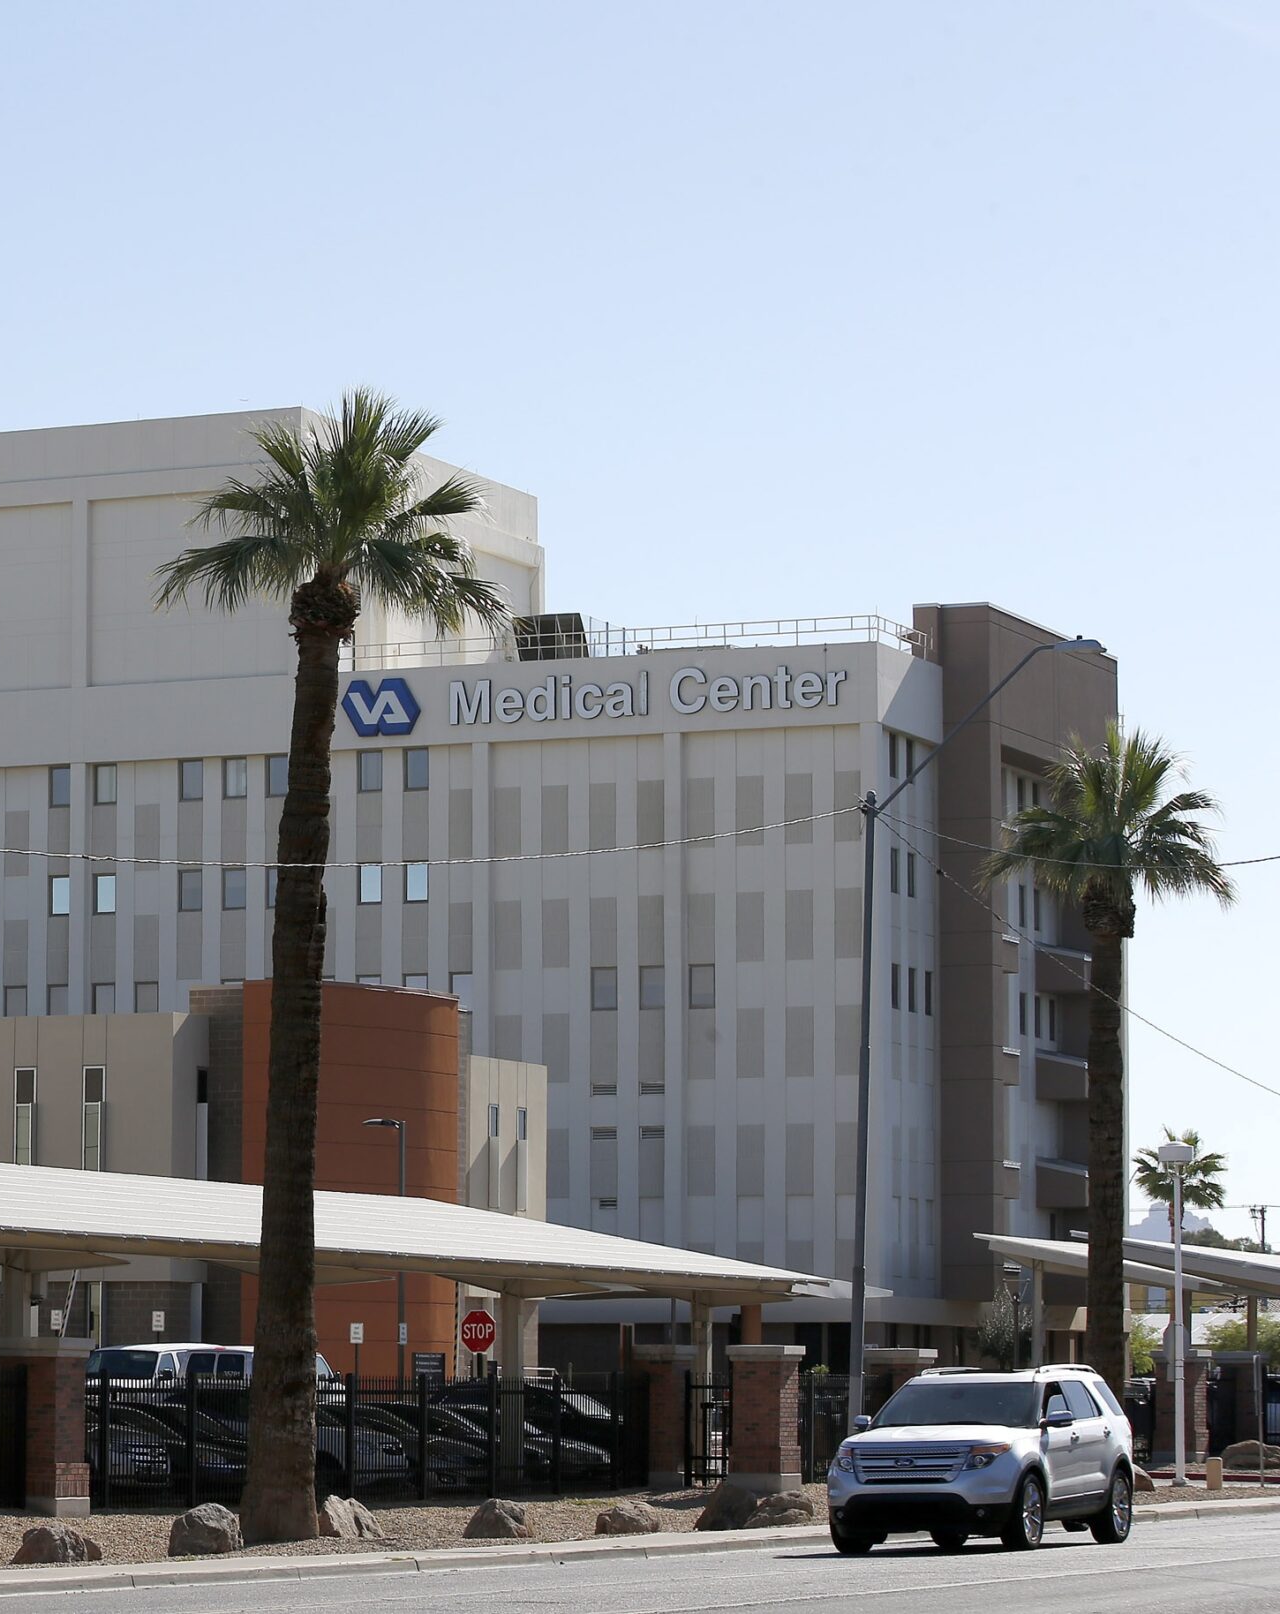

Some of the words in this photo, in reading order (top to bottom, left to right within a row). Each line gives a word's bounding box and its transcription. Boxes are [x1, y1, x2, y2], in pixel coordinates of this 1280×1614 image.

[347, 690, 411, 725] VA
[449, 671, 649, 726] Medical
[669, 666, 847, 715] Center
[463, 1323, 494, 1339] STOP
